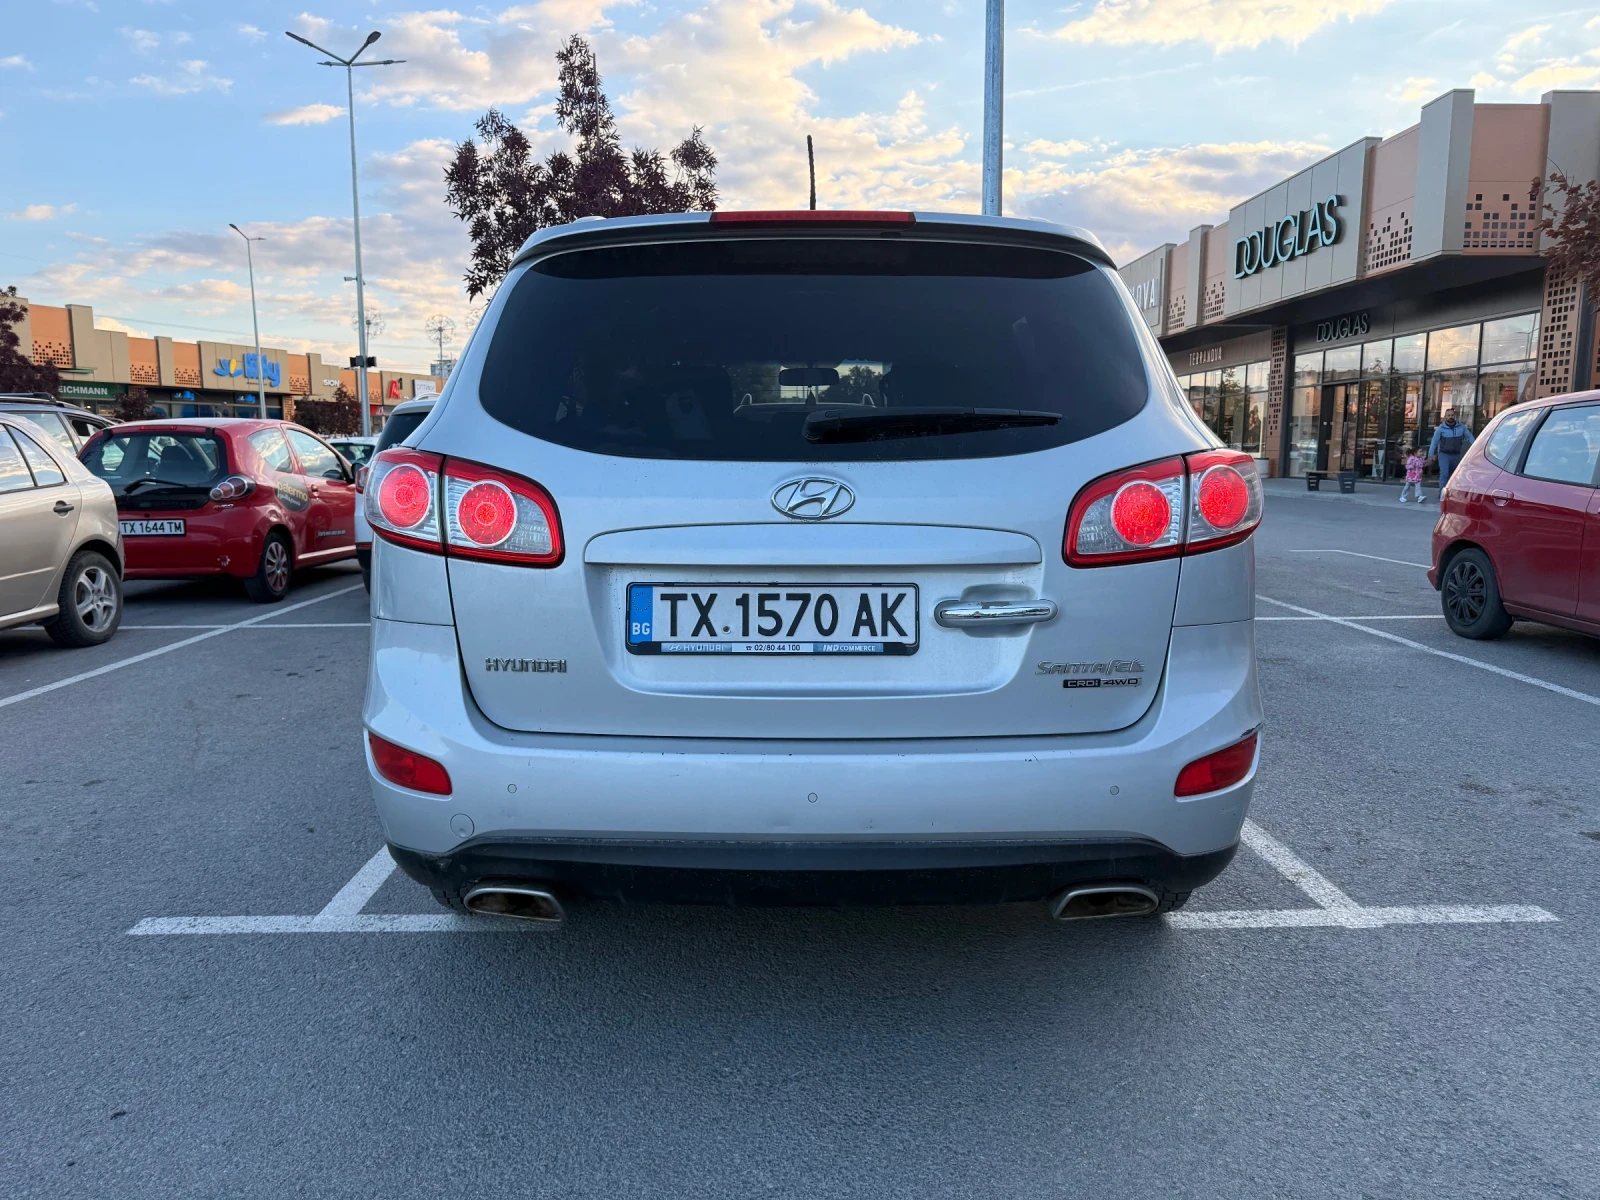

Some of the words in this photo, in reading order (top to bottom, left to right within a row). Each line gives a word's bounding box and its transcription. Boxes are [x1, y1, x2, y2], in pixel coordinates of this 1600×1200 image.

[1234, 194, 1340, 279] DOUGLAS
[1316, 313, 1369, 342] DOUGLAS
[1189, 347, 1222, 367] TERRANOVA
[276, 481, 308, 502] palermo
[121, 522, 136, 534] TX
[139, 520, 165, 533] 1644
[167, 521, 183, 533] TM
[660, 593, 718, 637] TX
[736, 593, 839, 637] 1570
[851, 593, 908, 637] AK
[632, 622, 651, 635] BG
[683, 643, 724, 652] HYUNDAI
[754, 644, 776, 652] 02/80
[776, 644, 786, 652] 44
[788, 644, 801, 652] 100
[485, 658, 567, 673] HYUNDAI
